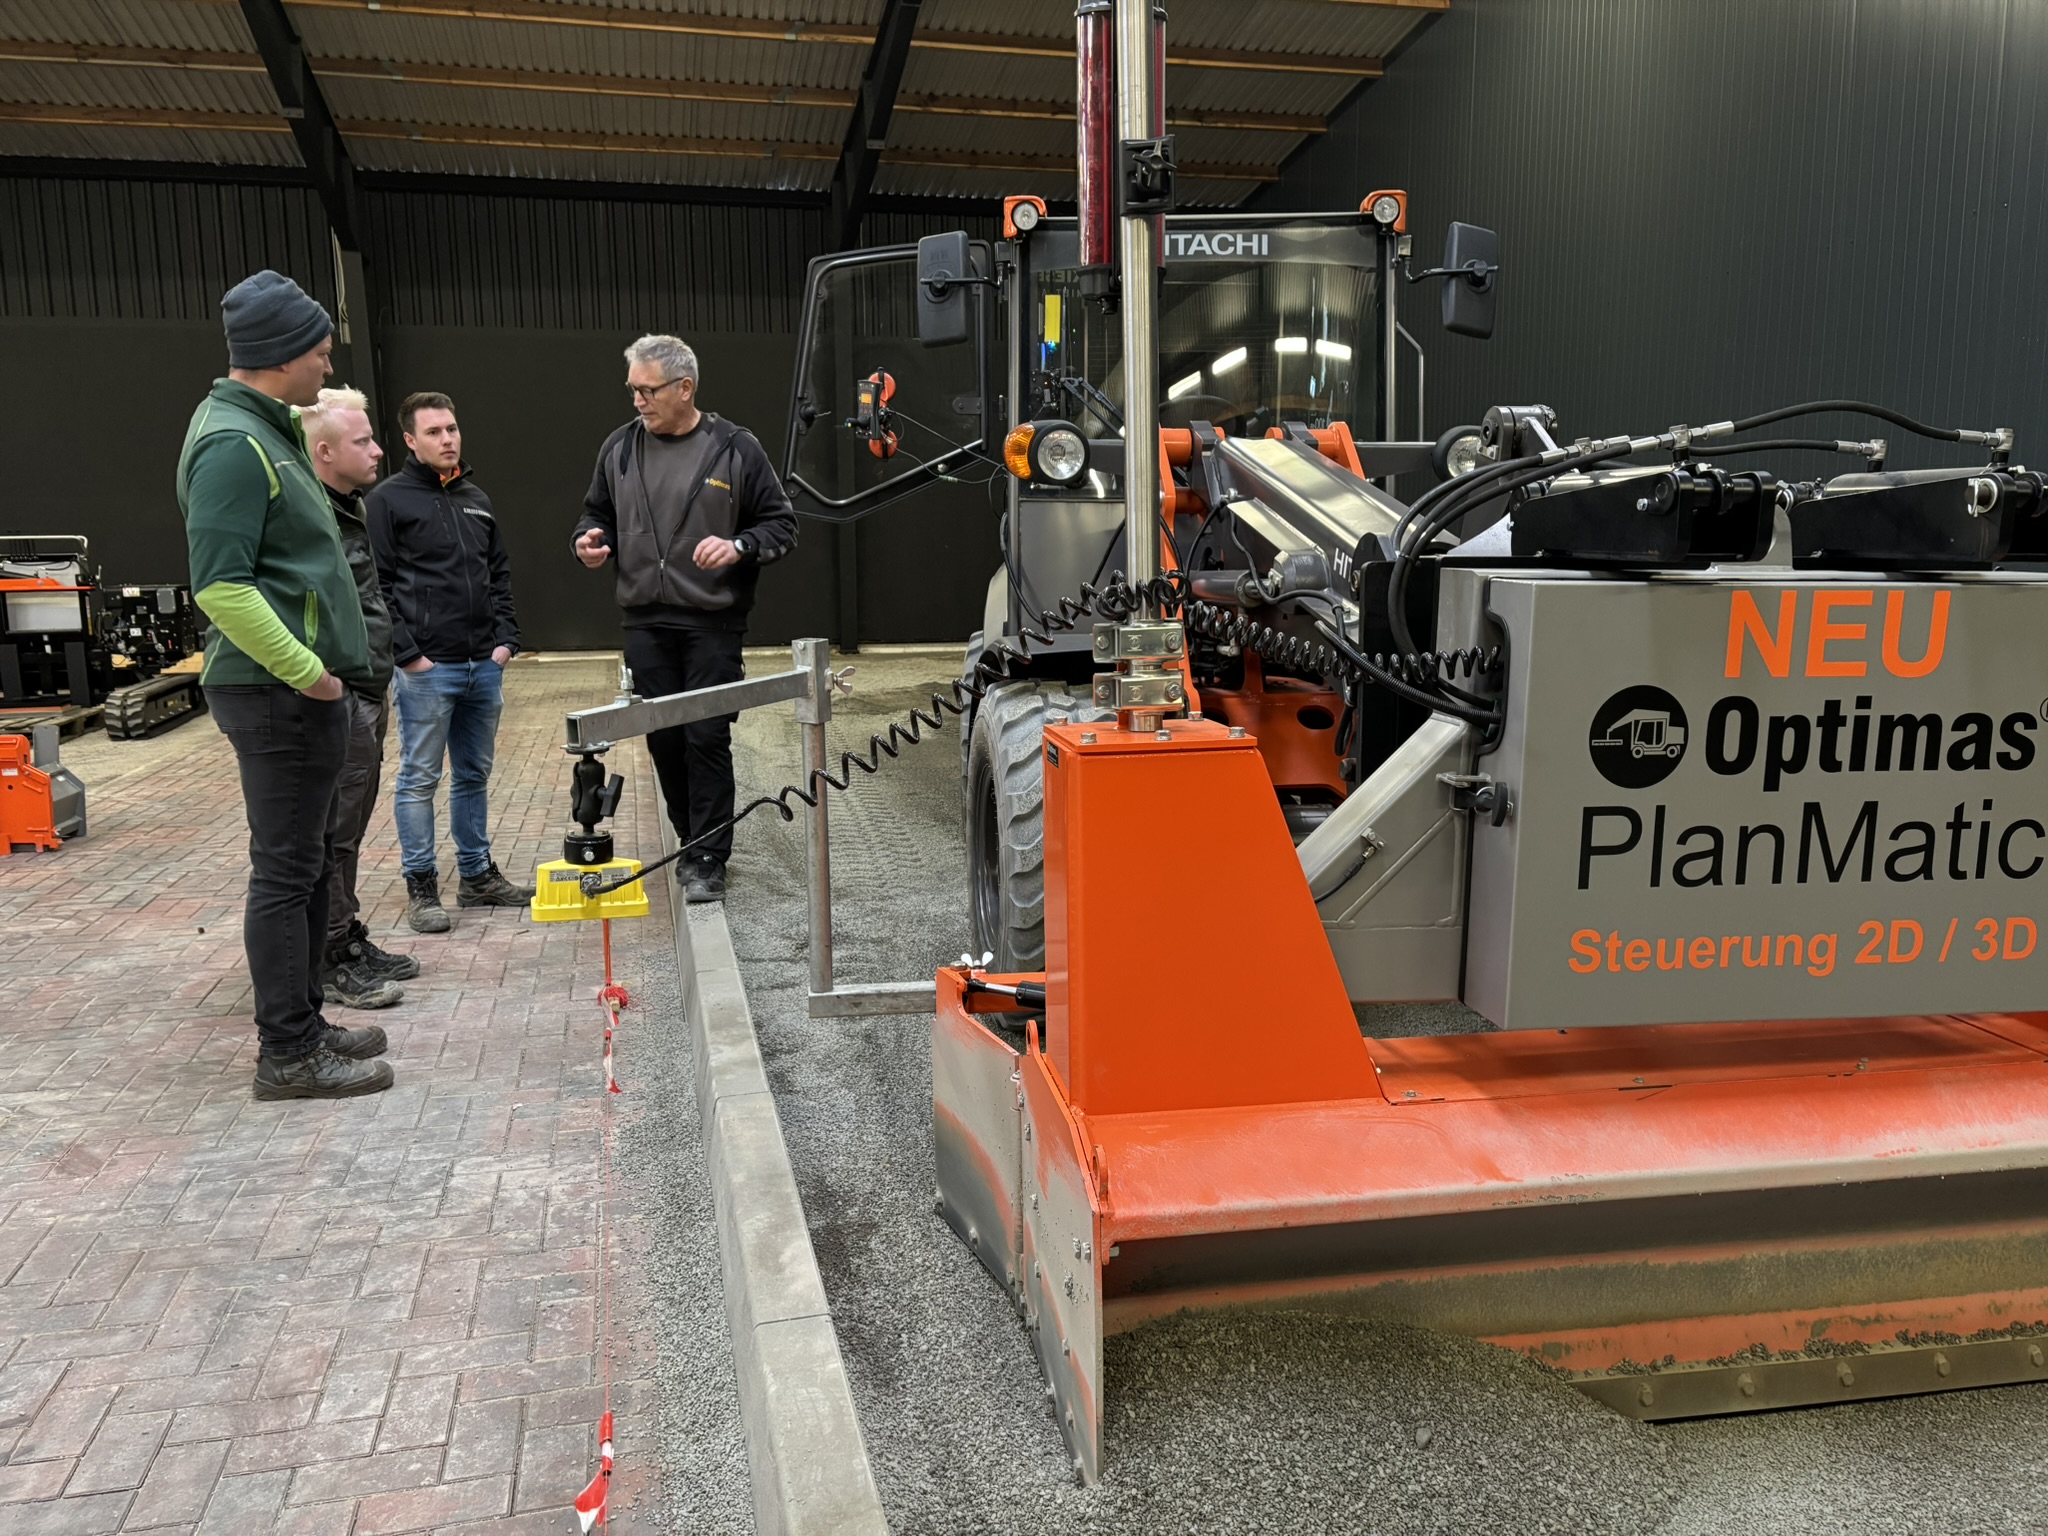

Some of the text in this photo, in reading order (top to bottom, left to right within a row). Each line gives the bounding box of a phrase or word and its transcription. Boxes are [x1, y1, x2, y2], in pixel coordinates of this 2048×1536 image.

[1164, 233, 1268, 256] ITACHI
[1723, 589, 1952, 679] NEU
[1705, 695, 2038, 793] Optimas
[1577, 798, 2046, 890] PlanMatic
[1567, 916, 2038, 978] Steuerung 2D / 3D
